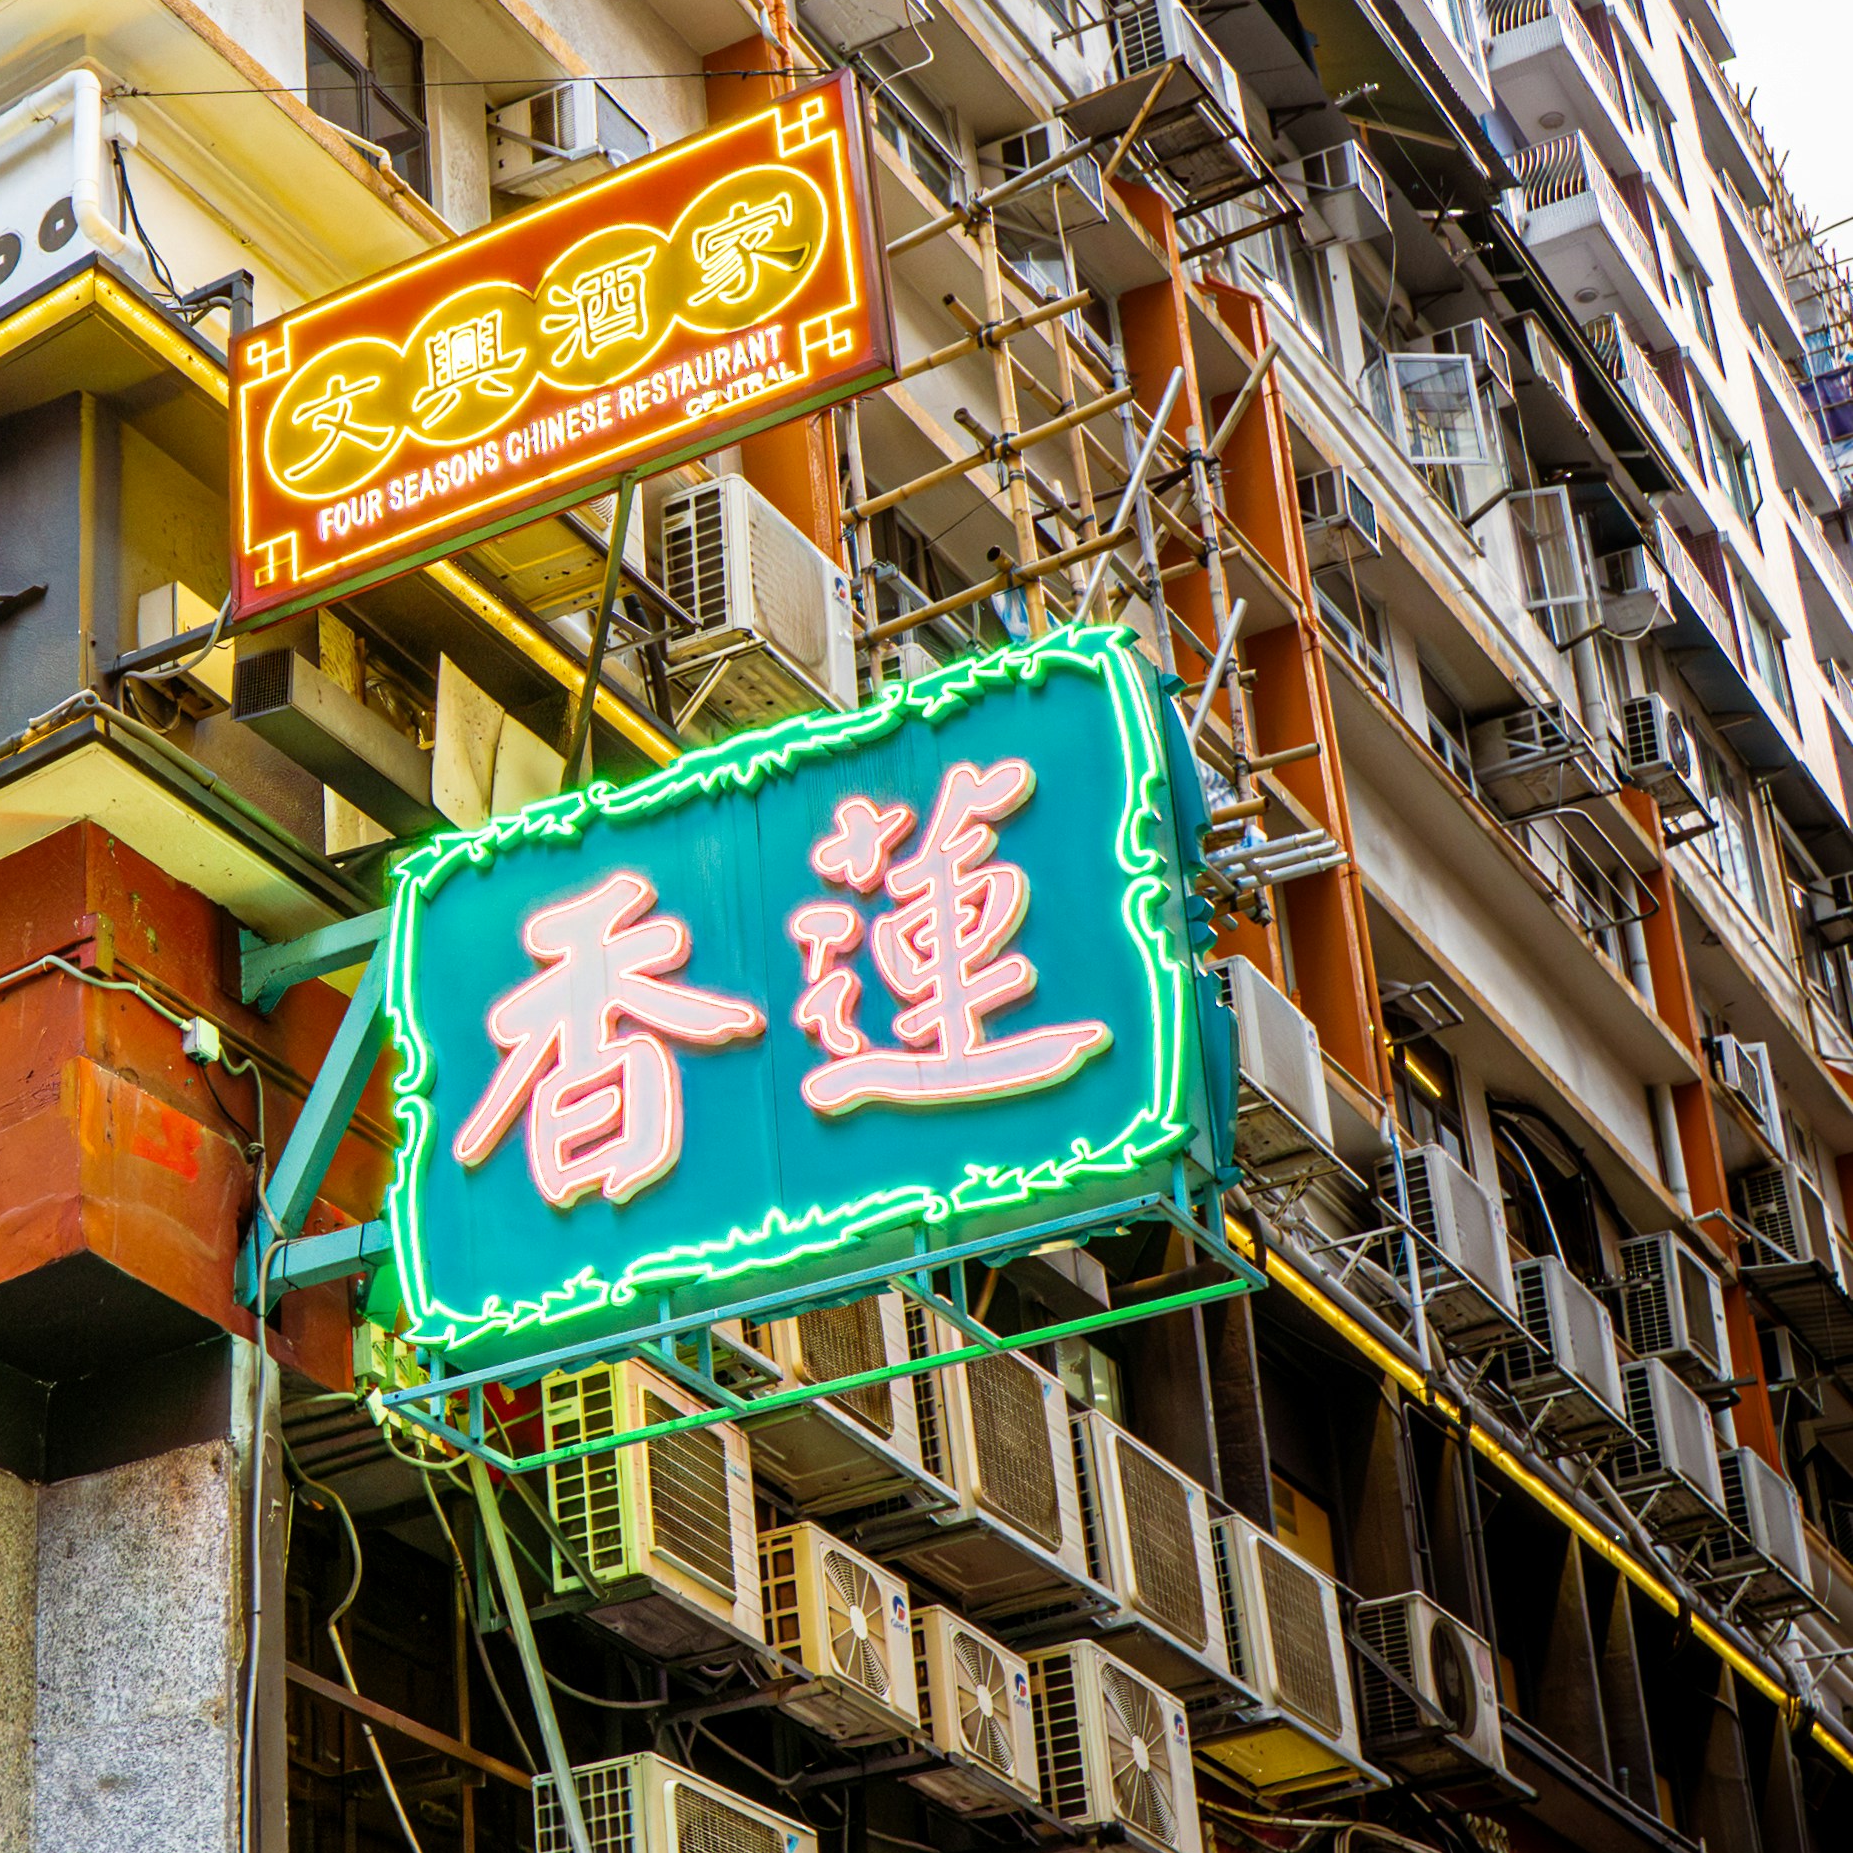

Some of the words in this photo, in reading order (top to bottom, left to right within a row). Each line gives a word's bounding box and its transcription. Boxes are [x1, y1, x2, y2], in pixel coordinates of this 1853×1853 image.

[285, 192, 811, 483] 文興酒家
[318, 487, 386, 541] FOUR
[388, 445, 501, 513] SEASONS
[506, 402, 615, 467] CHINESE
[618, 324, 785, 421] RESTAURANT
[685, 359, 796, 419] CENTRAL
